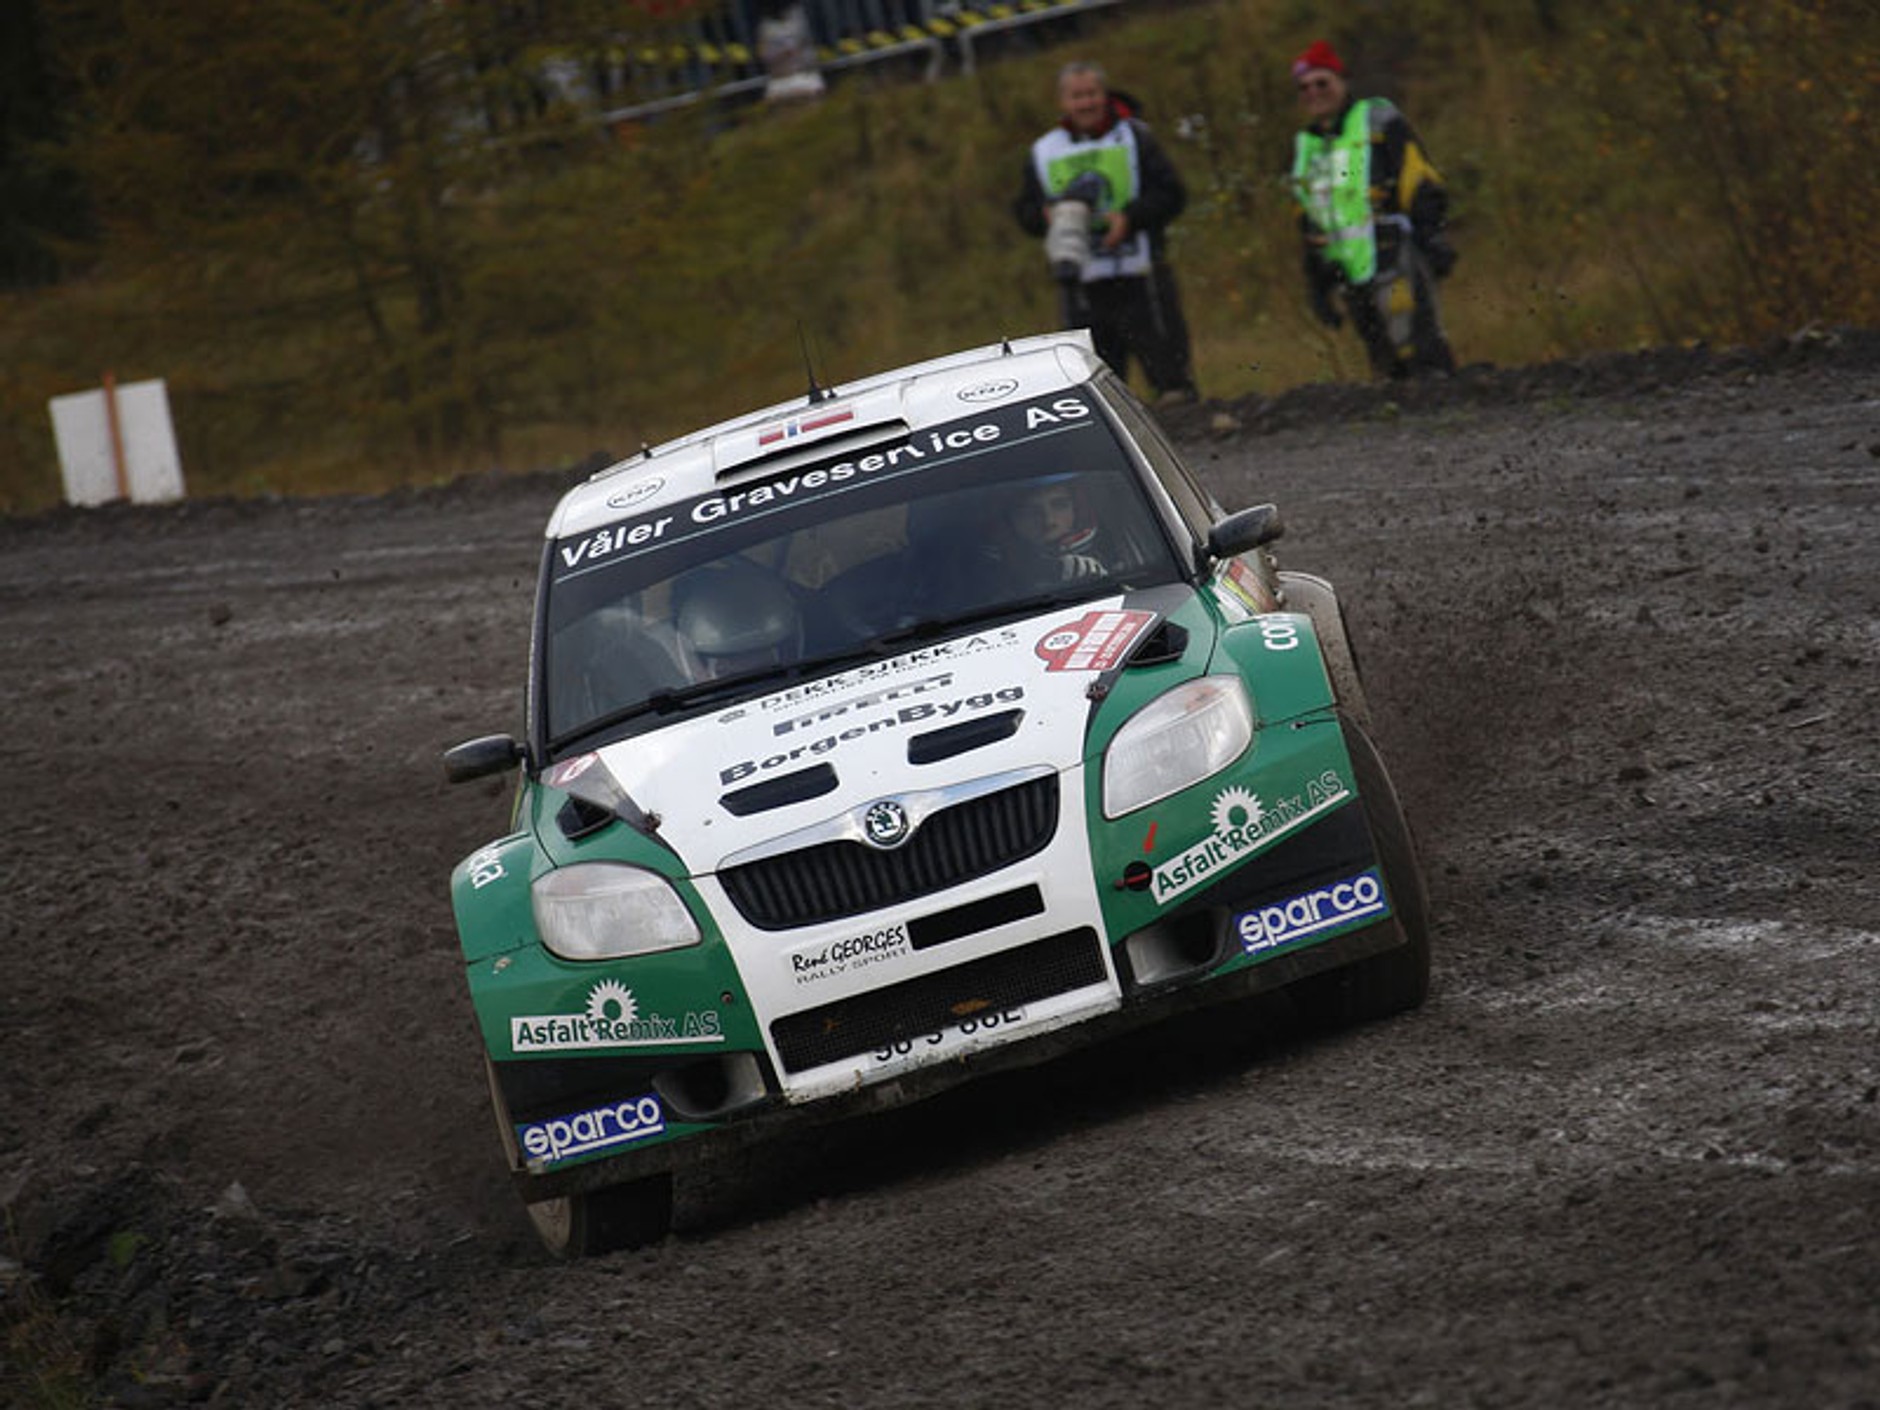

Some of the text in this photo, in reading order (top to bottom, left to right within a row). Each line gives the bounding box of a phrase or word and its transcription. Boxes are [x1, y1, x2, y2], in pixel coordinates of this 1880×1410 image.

[561, 516, 673, 568] Våler
[1025, 397, 1091, 430] AS
[761, 676, 847, 708] DEKK
[860, 644, 954, 677] SJEKK
[719, 686, 1025, 786] BorgenBygg
[1157, 771, 1344, 897] Asfalt Remix AS
[1239, 876, 1380, 947] sparco
[792, 925, 905, 972] René GEORGES
[517, 1010, 721, 1045] Asfalt Remix AS
[523, 1097, 660, 1159] sparco
